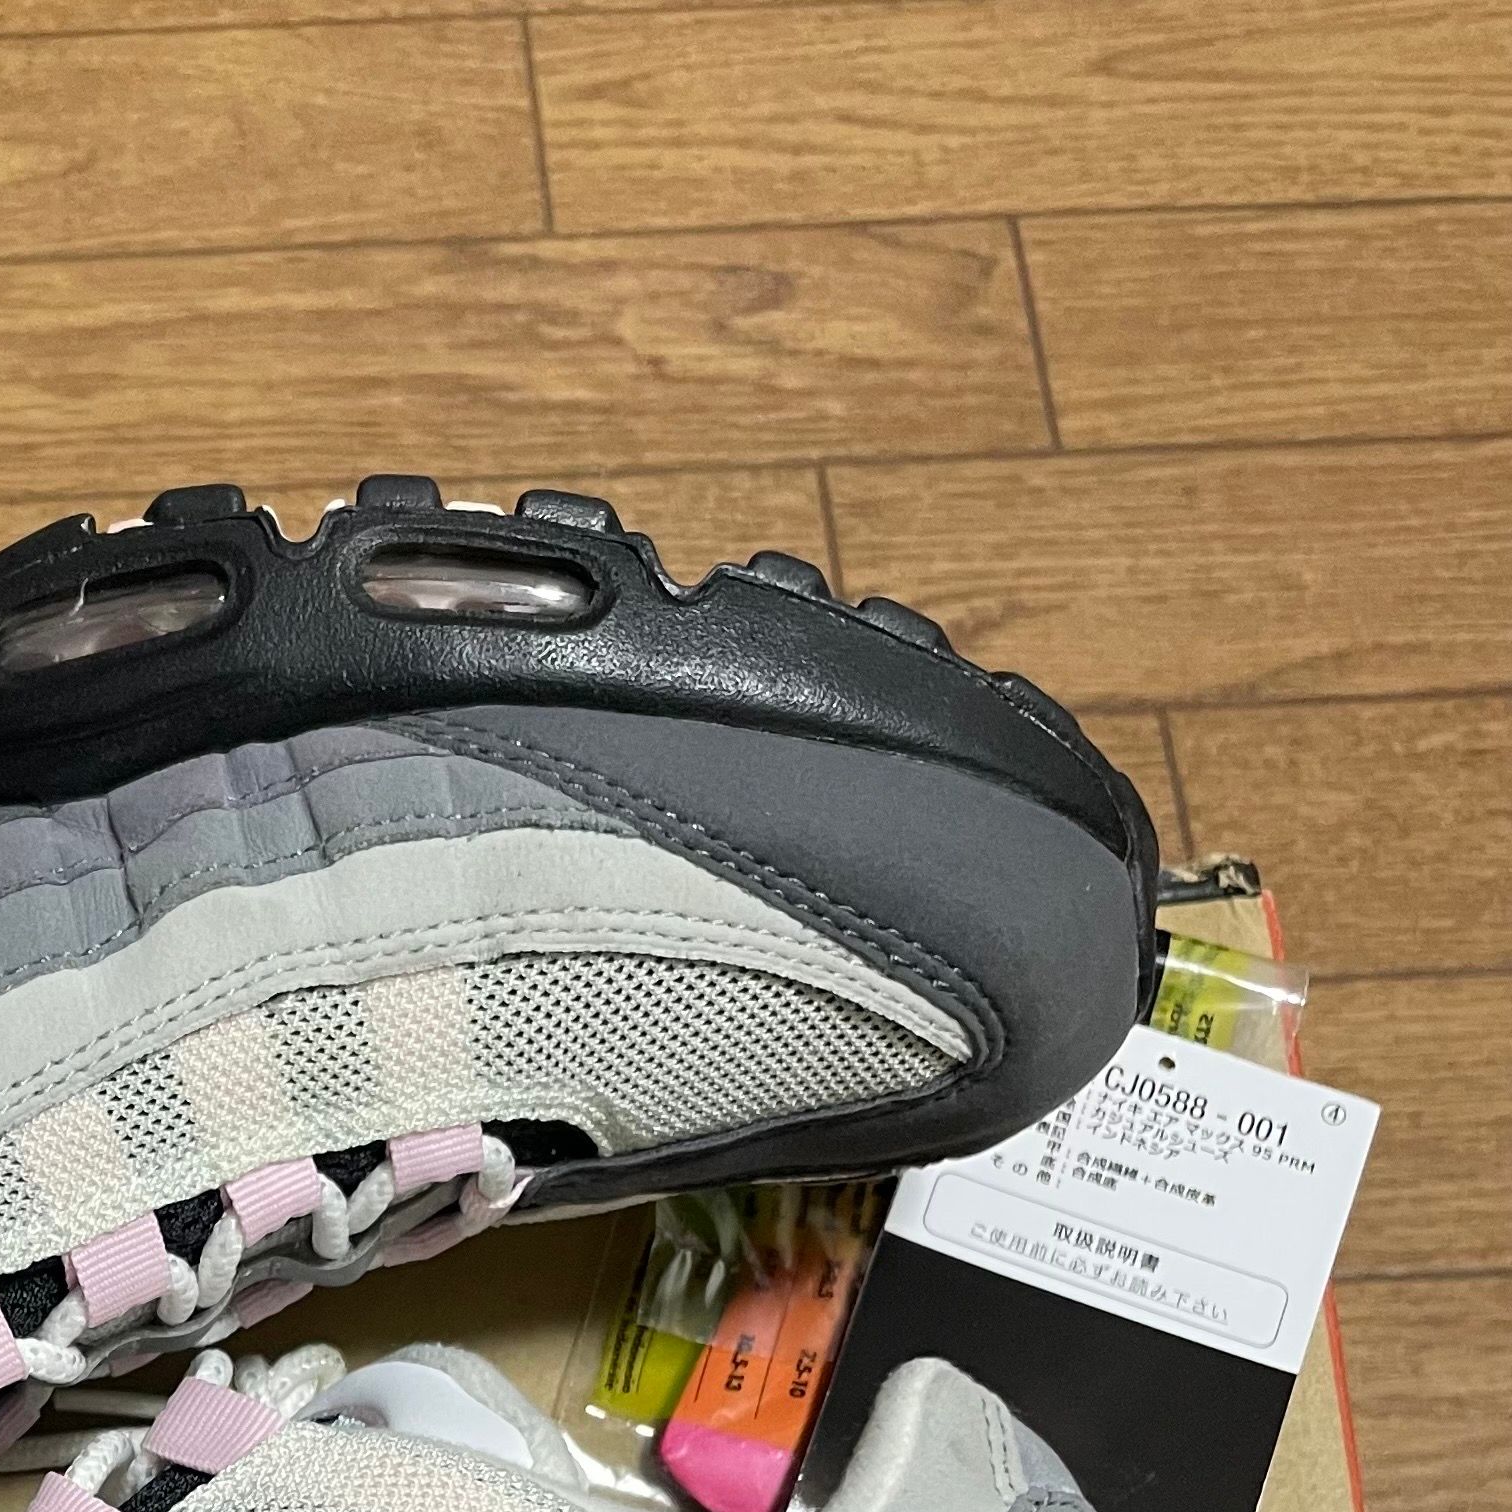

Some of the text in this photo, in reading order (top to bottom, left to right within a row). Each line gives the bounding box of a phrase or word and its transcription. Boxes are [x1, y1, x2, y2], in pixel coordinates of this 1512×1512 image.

[1104, 1065, 1208, 1120] CJ0588
[1237, 1111, 1289, 1147] 001
[1053, 1221, 1160, 1273] 取扱説明書
